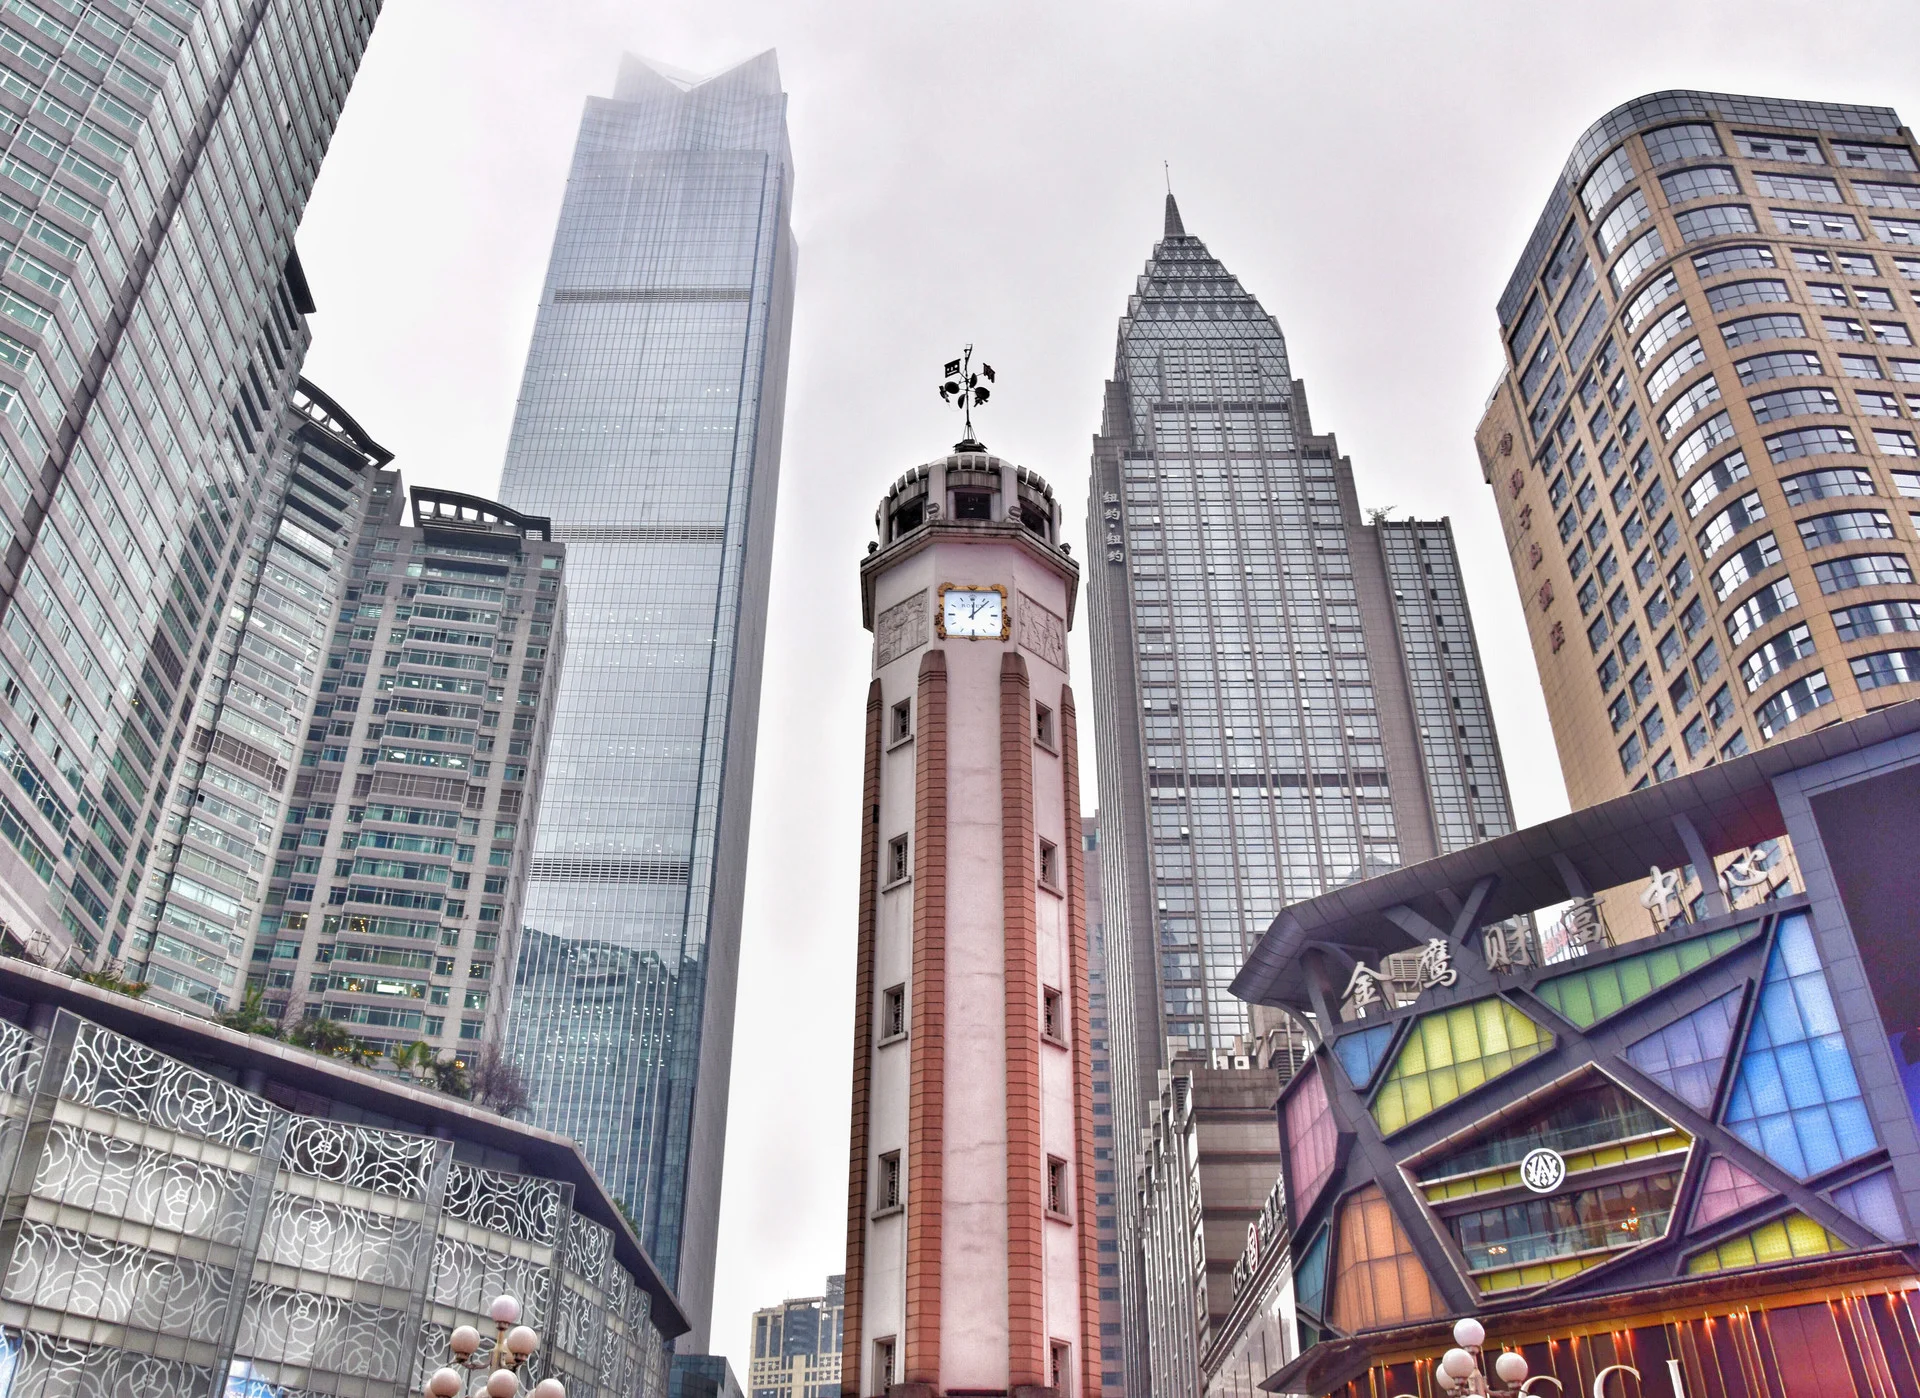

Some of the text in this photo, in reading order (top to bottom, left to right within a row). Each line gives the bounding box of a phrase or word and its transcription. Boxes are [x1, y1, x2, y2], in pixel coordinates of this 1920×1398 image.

[1341, 848, 1769, 1010] 金鹰财富中心
[1230, 1250, 1247, 1298] ICBC
